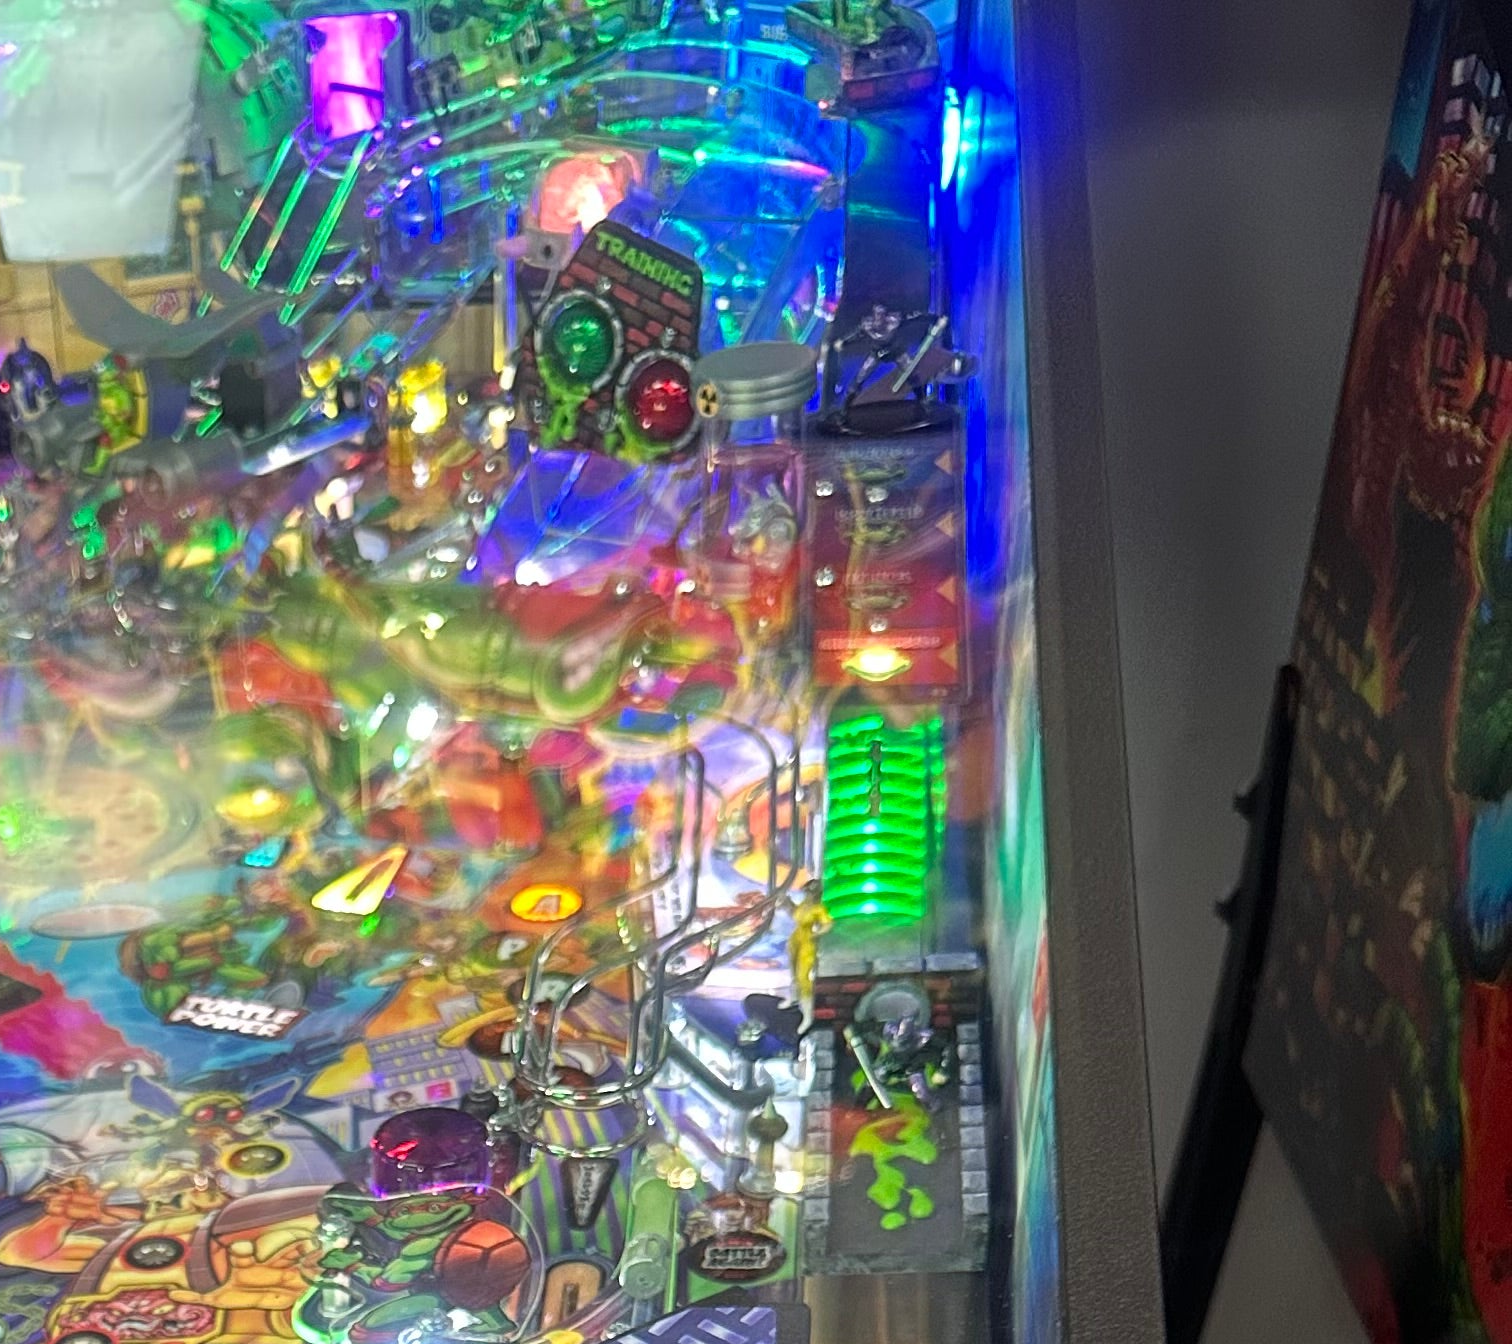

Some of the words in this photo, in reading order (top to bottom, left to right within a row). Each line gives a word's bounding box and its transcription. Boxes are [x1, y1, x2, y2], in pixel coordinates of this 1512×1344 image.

[595, 230, 694, 297] TRAINING
[531, 894, 563, 915] A
[169, 1009, 283, 1037] POWER
[183, 996, 300, 1024] TURTLE
